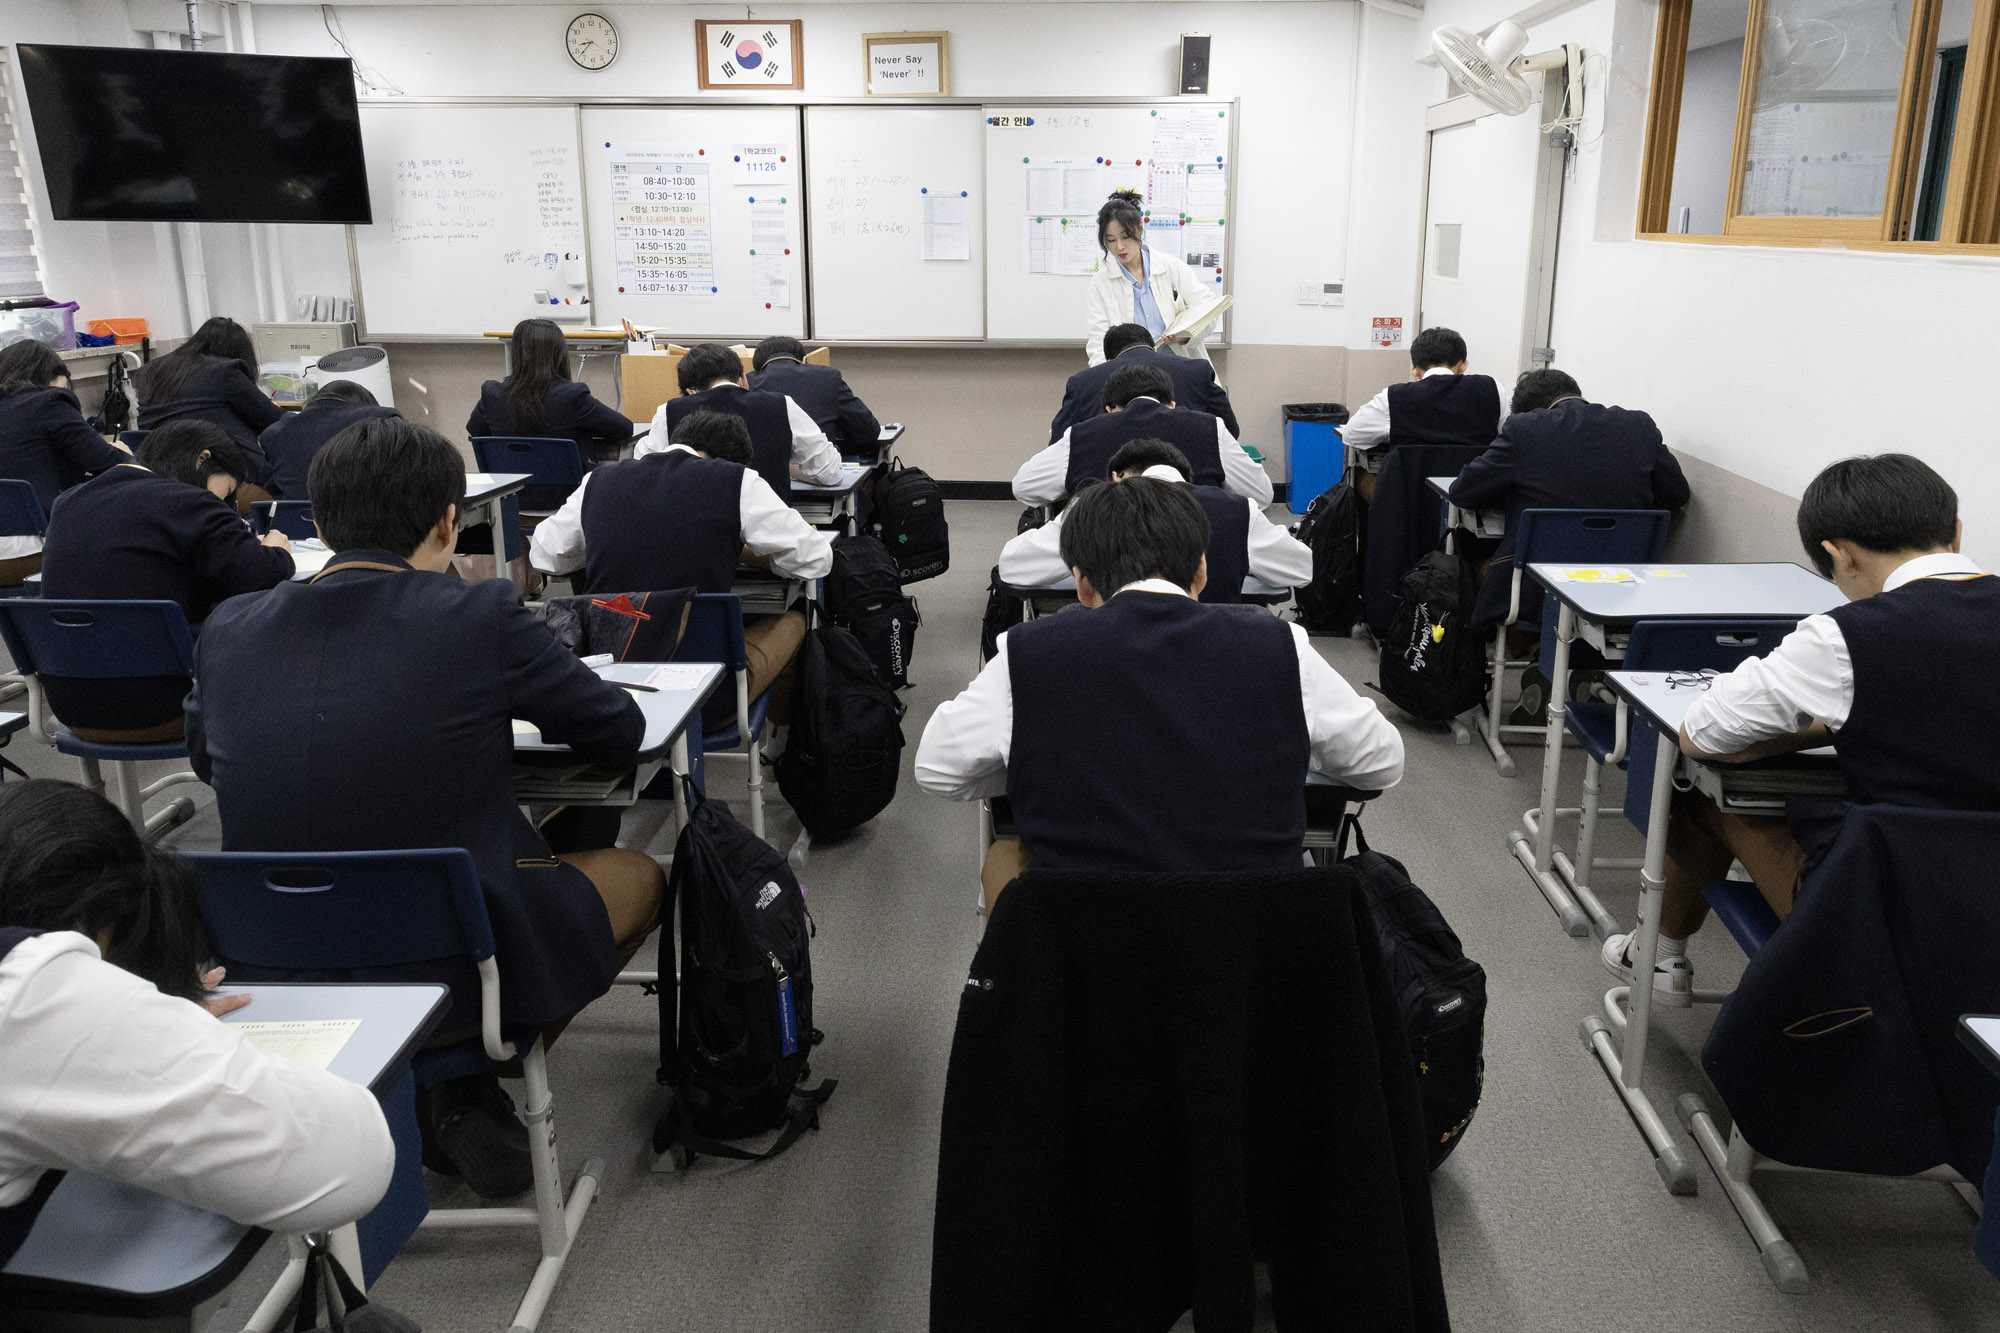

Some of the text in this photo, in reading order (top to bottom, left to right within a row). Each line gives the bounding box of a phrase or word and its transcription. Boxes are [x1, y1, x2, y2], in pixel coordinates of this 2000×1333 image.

[874, 55, 922, 64] Never Say
[918, 69, 924, 78] !!
[992, 116, 1032, 126] 월간 안내
[744, 147, 776, 156] [학교코드]
[746, 162, 776, 172] 11126
[644, 177, 696, 186] 08:40~10:00
[645, 192, 696, 200] 10:30~12:10
[680, 216, 706, 224] 점심식사
[634, 228, 684, 236] 13:10~14:20
[636, 242, 686, 250] 14:50~15:20
[636, 256, 686, 264] 15:20~15:35
[638, 270, 688, 278] 15:35~16:05
[638, 284, 688, 292] 16:07~16:37
[900, 560, 944, 578] Dscovery
